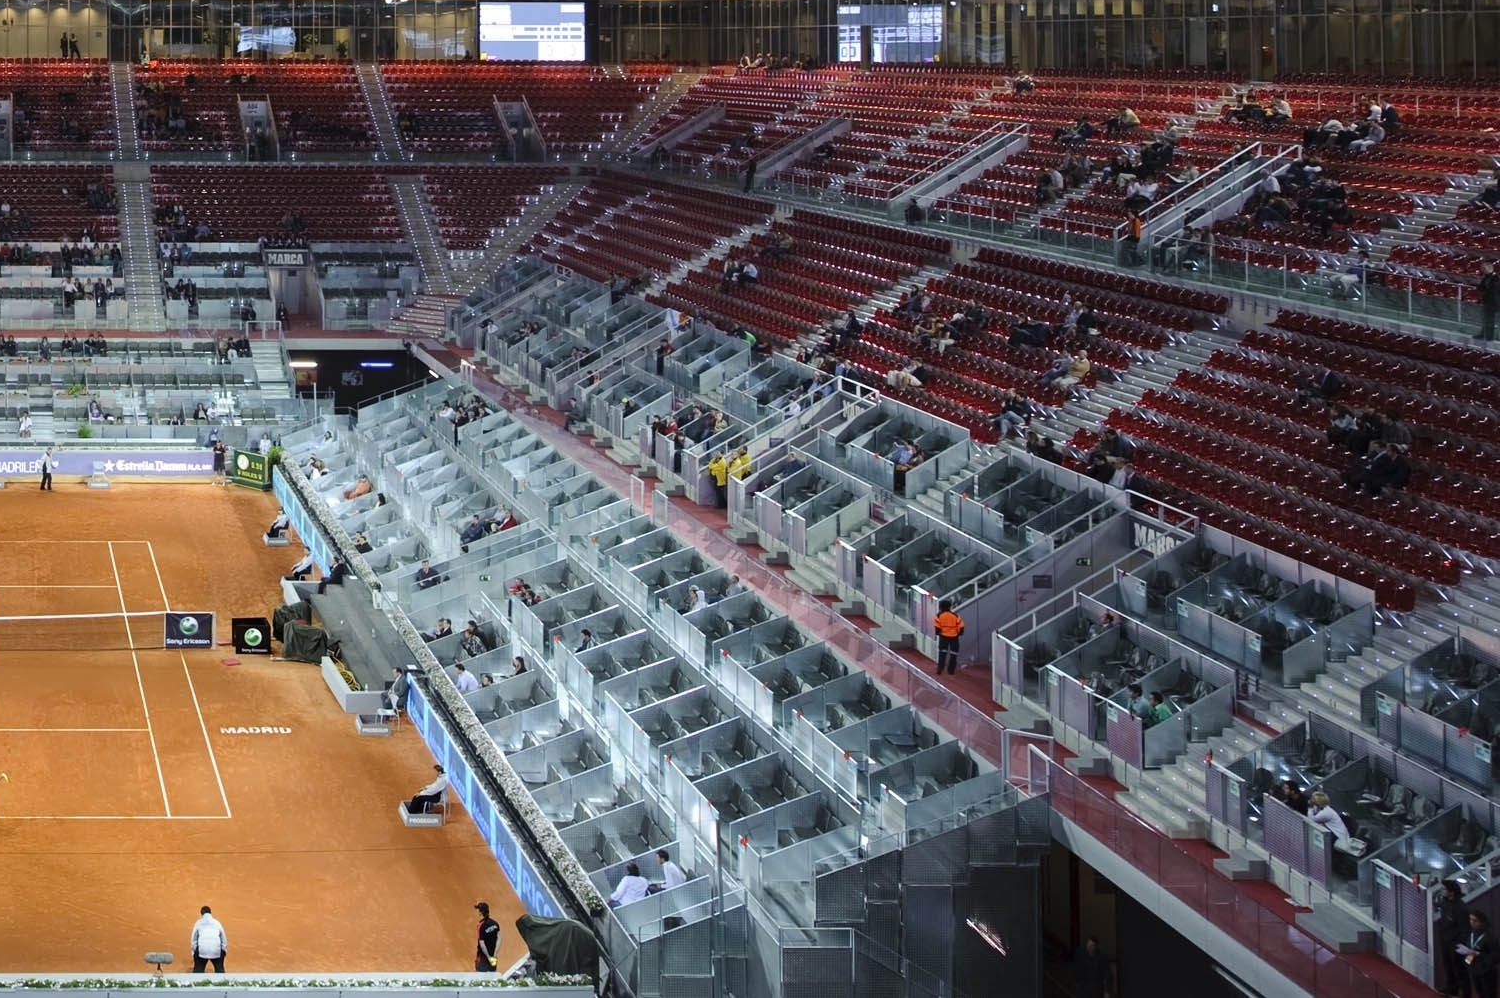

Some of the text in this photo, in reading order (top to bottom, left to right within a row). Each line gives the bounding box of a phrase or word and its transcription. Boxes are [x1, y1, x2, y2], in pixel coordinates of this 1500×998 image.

[267, 253, 304, 265] MARCA
[166, 638, 182, 646] Sony
[220, 726, 292, 735] MADRID
